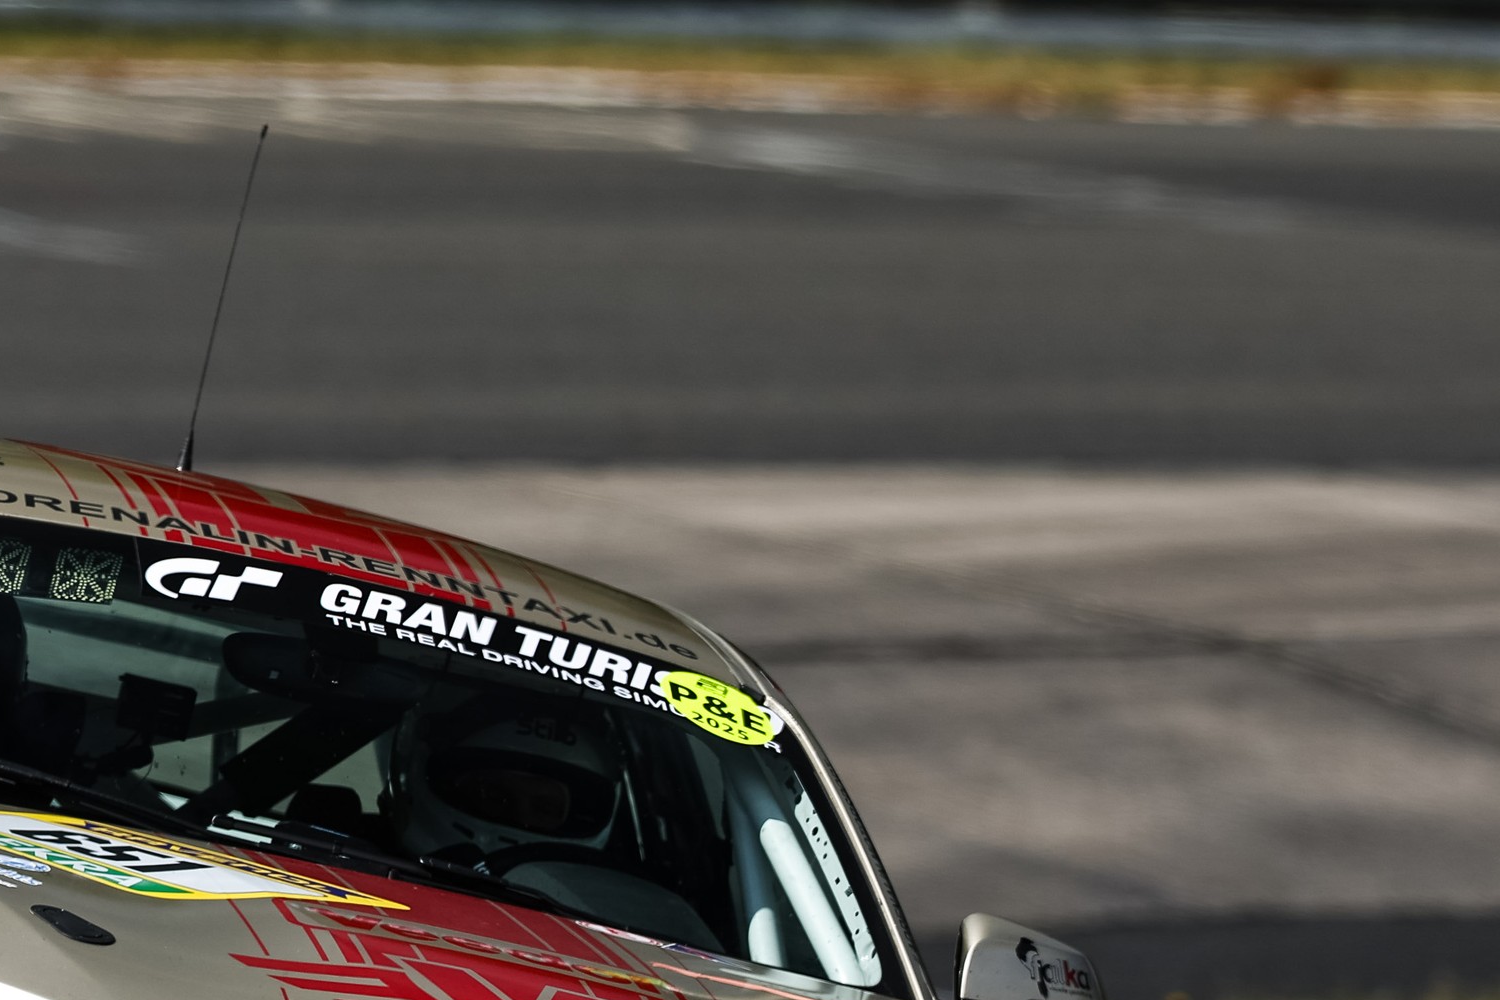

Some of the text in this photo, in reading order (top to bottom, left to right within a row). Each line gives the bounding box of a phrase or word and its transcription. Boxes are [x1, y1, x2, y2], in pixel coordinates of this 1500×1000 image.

[320, 583, 497, 647] GRAN
[325, 613, 387, 637] THE
[396, 628, 476, 656] REAL
[482, 648, 606, 692] DRIVING
[668, 681, 768, 736] P&E
[691, 711, 750, 741] 2025
[8, 829, 218, 874] 651
